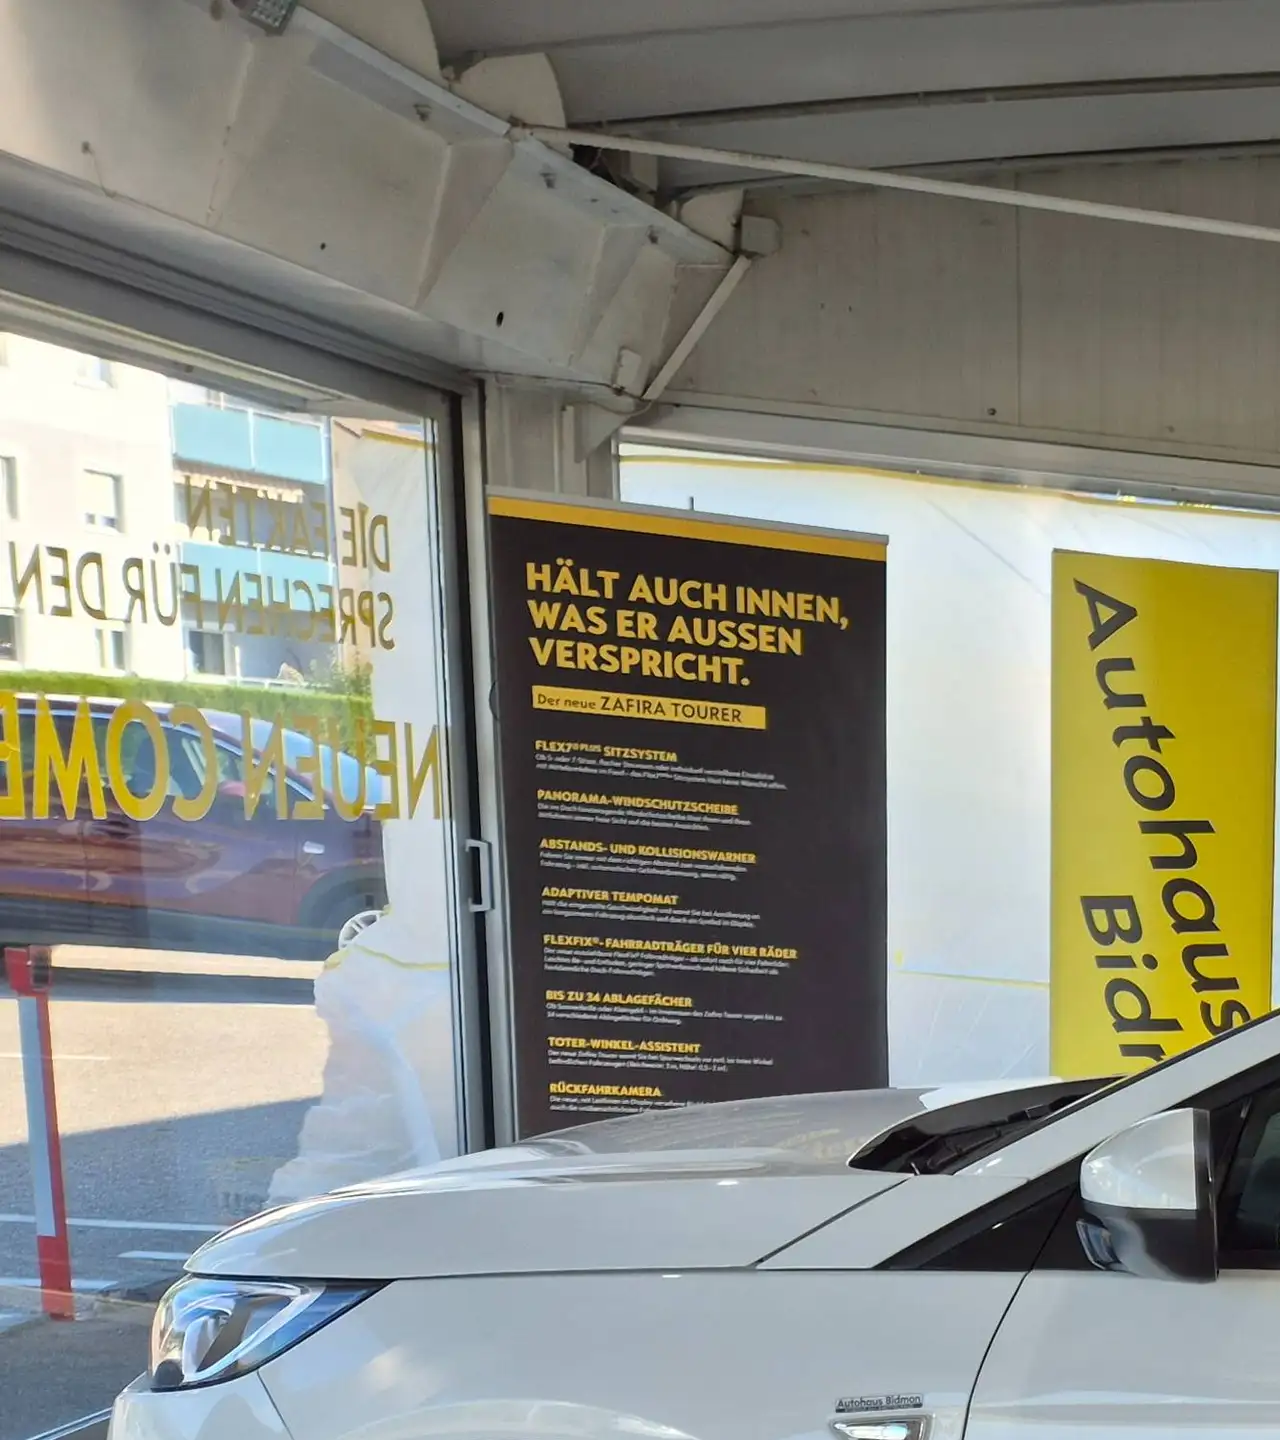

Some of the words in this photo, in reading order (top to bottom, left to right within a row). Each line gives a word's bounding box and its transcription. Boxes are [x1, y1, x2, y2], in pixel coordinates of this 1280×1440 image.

[526, 558, 620, 599] HÄLT
[628, 574, 727, 612] AUCH
[736, 585, 850, 631] INNEN,
[527, 600, 607, 636] WAS
[616, 609, 659, 641] ER
[668, 615, 804, 656] AUSSEN
[529, 637, 751, 687] VERSPRICHT.
[537, 693, 560, 707] Der
[564, 698, 596, 710] neue
[600, 695, 667, 717] ZAFIRA
[671, 702, 742, 724] TOURER
[603, 746, 678, 763] SITZSYSTEM
[1073, 578, 1250, 1036] Autohaus
[539, 838, 608, 853] ABSTANDS-
[610, 843, 636, 855] UND
[638, 845, 757, 864] KOLLISIONSWARNER
[542, 886, 609, 901] ADAPTIVER
[612, 891, 679, 905] TEMPOMAT
[707, 942, 729, 956] FÜR
[731, 945, 757, 958] VIER
[759, 945, 798, 960] RÄDER
[546, 990, 564, 1001] BIS
[567, 991, 584, 1002] ZU
[602, 992, 692, 1008] ABLAGEFÄCHER
[547, 1036, 701, 1054] TOTER-WINKEL-ASSISTENT
[549, 1082, 663, 1097] RÜCKFAHRKAMERA
[837, 1396, 883, 1408] Autohaus
[886, 1394, 920, 1406] Bidmon
